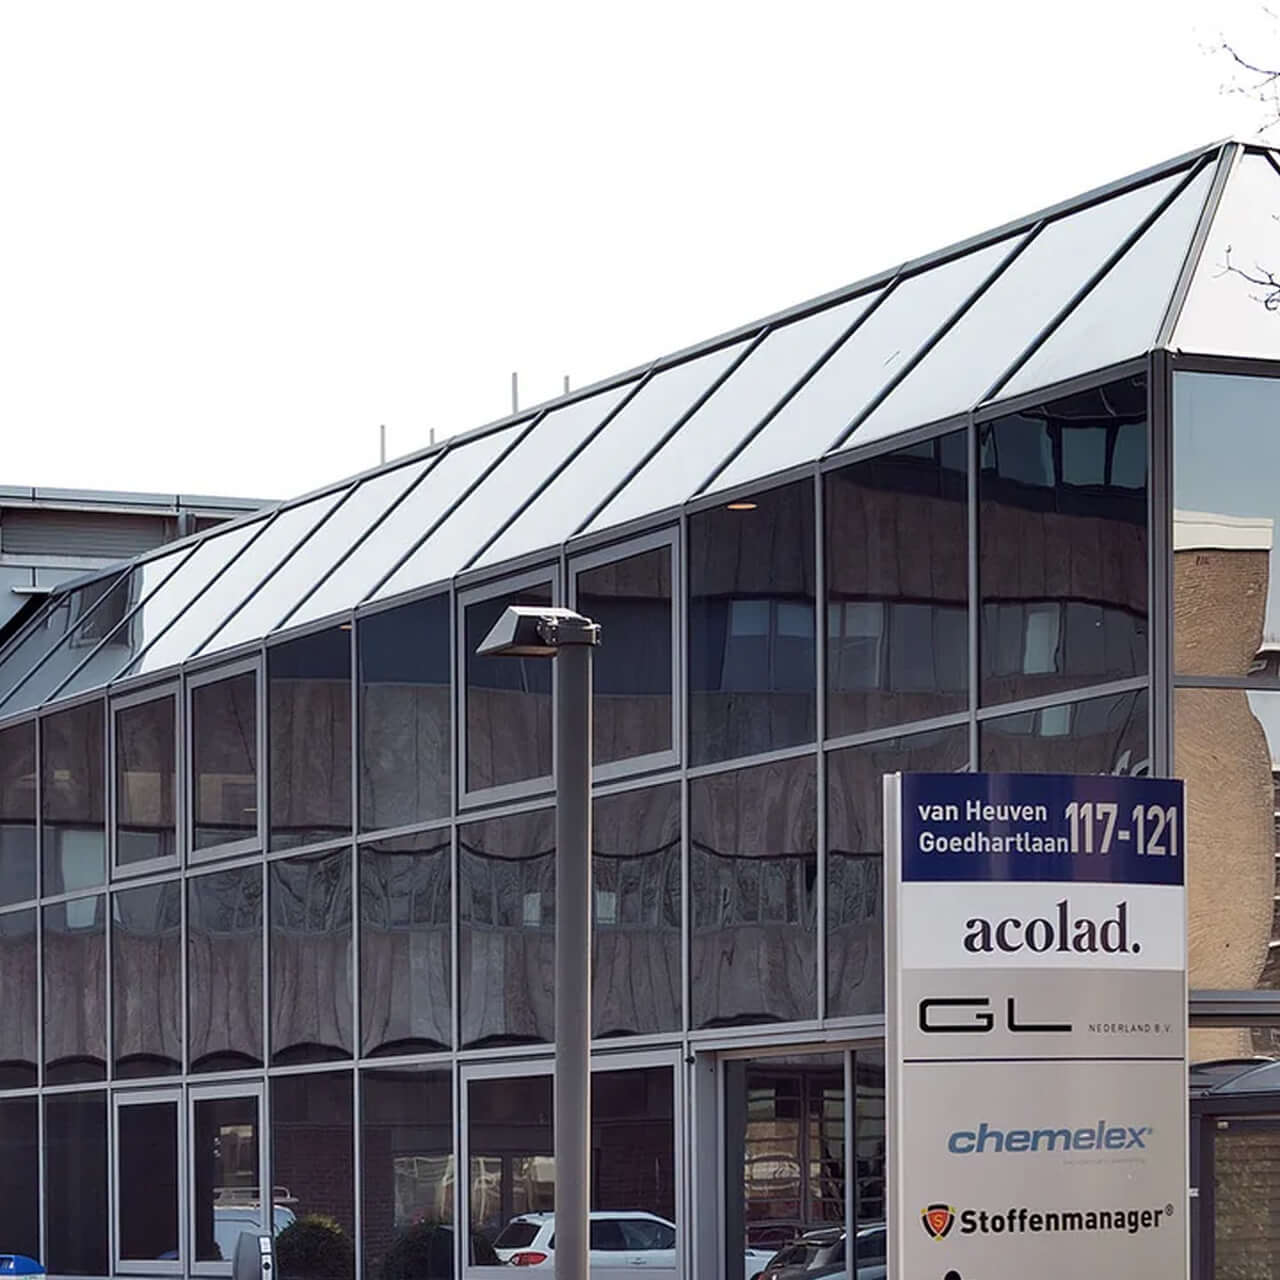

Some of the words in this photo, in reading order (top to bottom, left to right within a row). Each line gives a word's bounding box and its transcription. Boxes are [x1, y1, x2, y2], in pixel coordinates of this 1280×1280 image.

[918, 804, 959, 821] van
[966, 801, 1047, 821] Heuven
[919, 831, 1068, 852] Goedhartlaan
[1065, 802, 1178, 856] 117-121
[963, 899, 1141, 953] acolad.
[919, 998, 1072, 1033] GL
[1088, 1023, 1151, 1033] NEDERLAND
[948, 1120, 1149, 1154] chemelex
